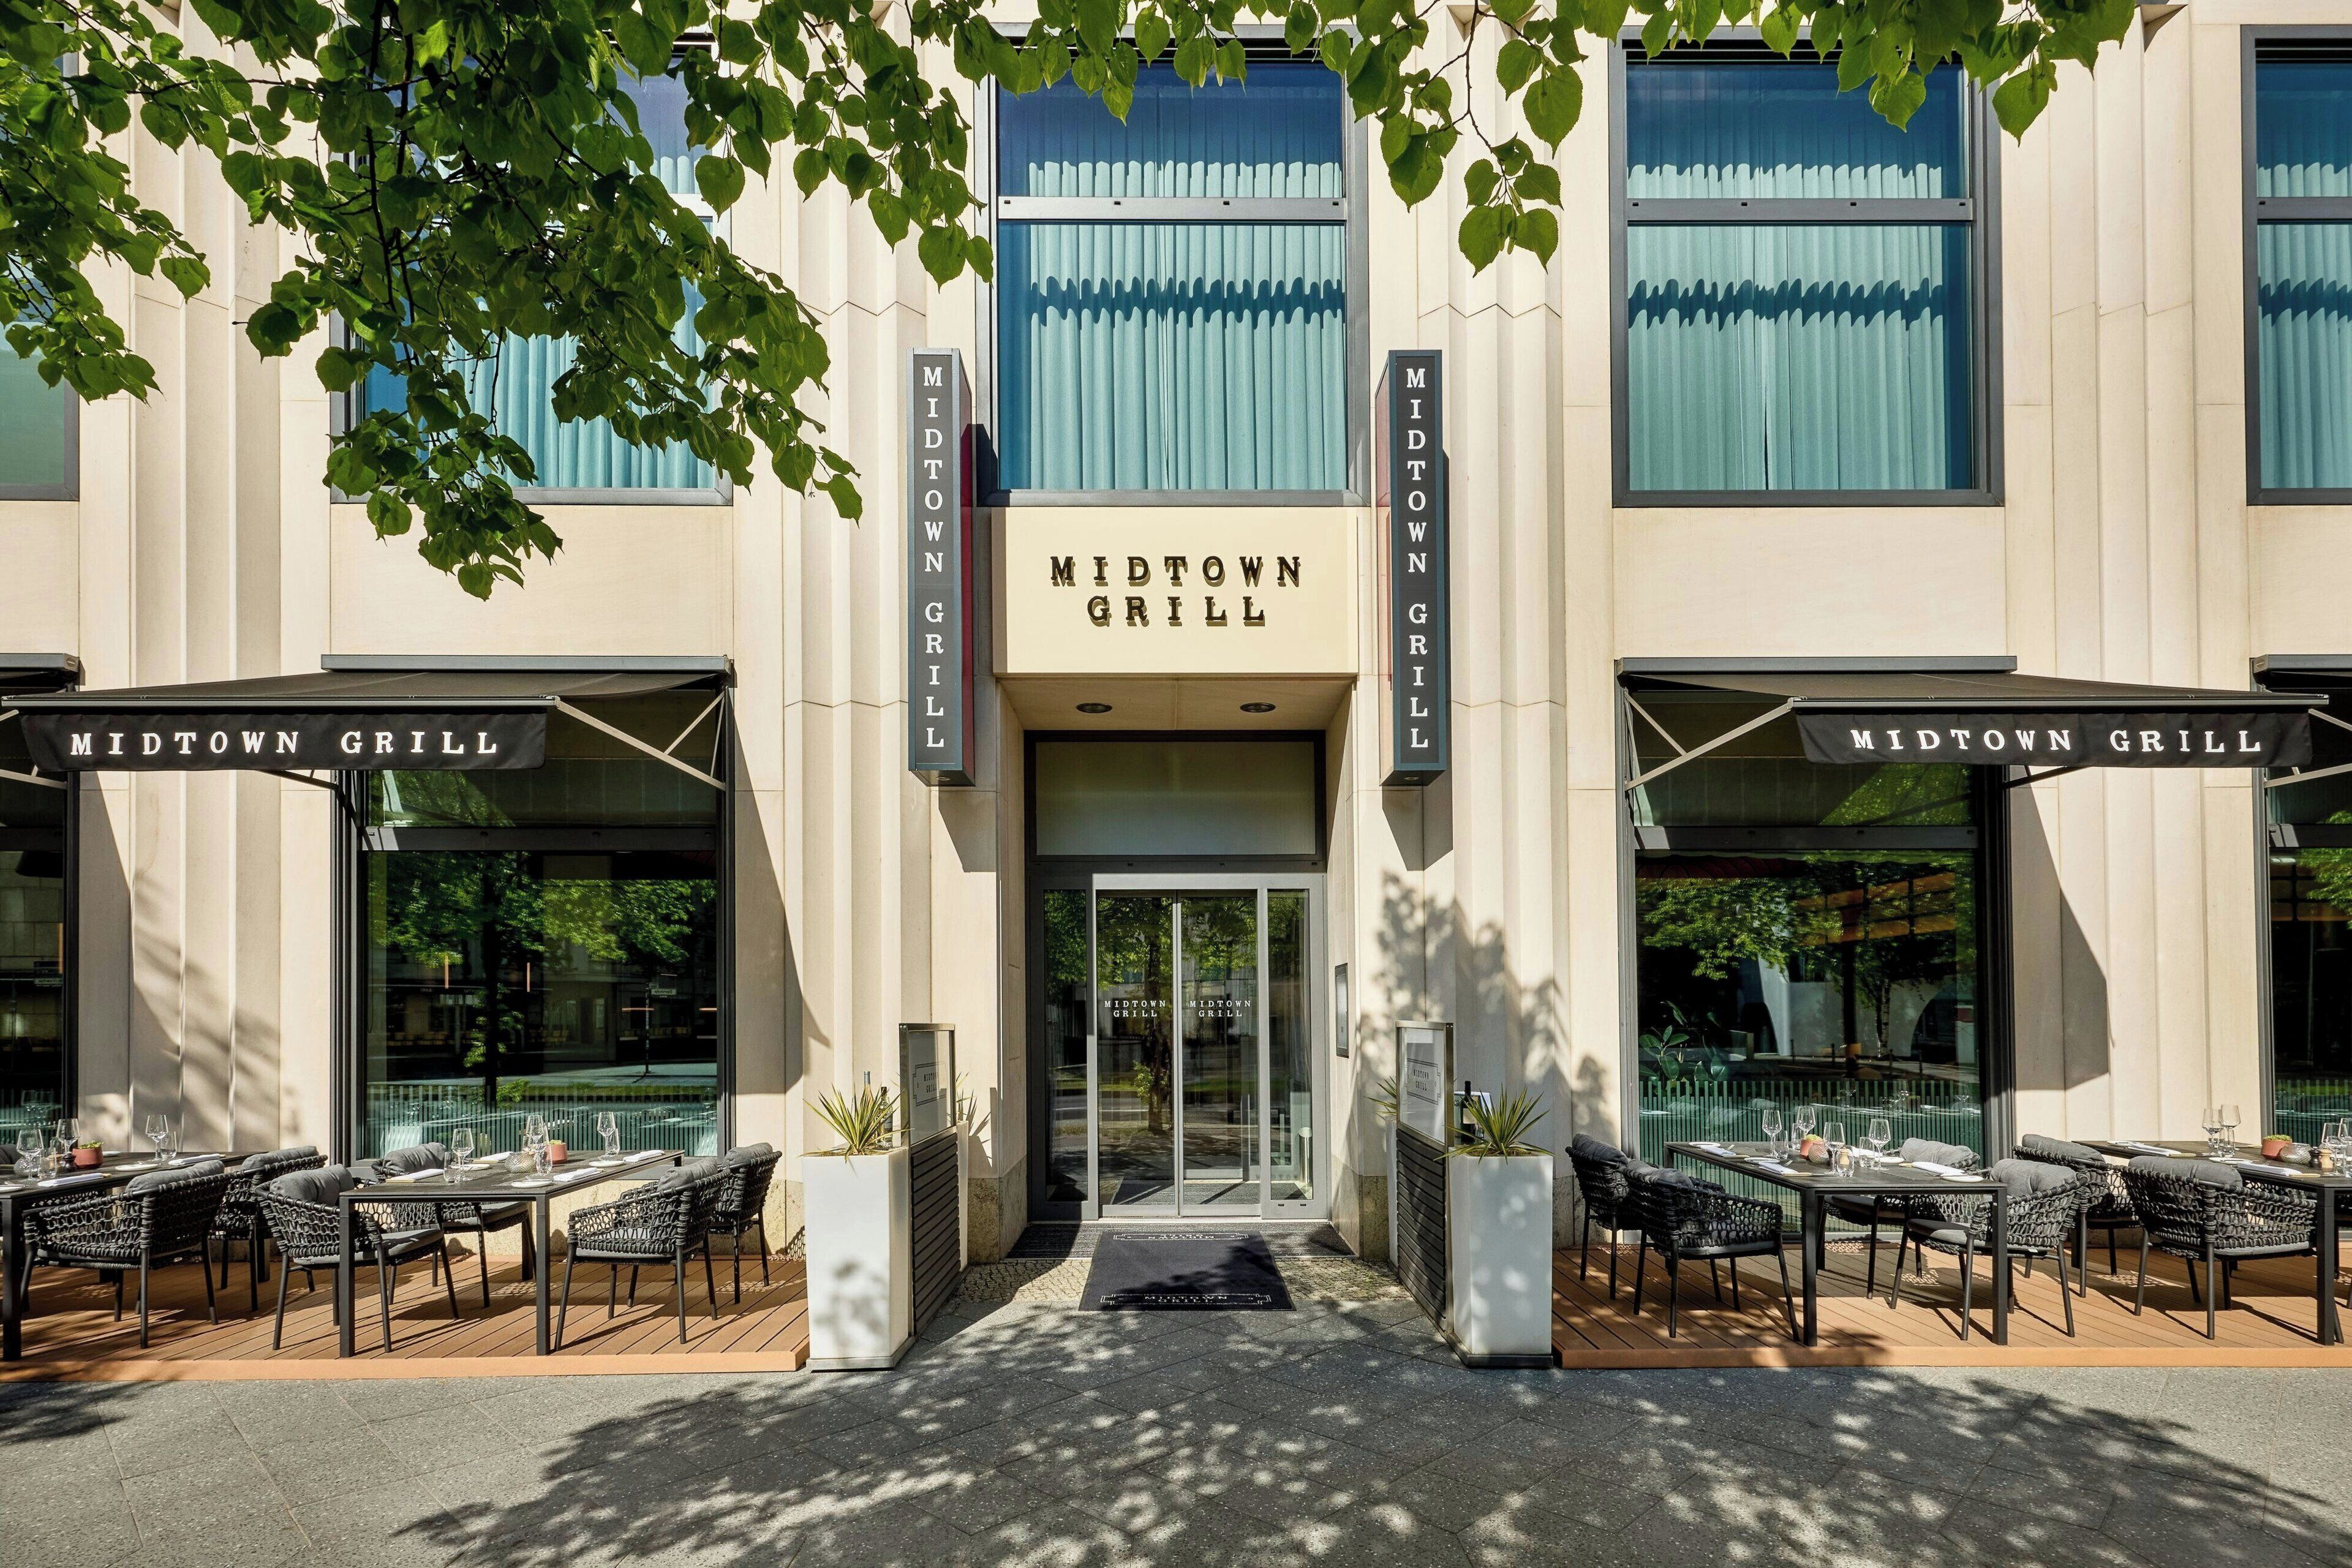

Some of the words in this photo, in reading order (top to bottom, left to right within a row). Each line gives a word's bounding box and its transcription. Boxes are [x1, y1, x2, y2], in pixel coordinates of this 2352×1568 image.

[923, 366, 944, 573] MIDTOWN
[1406, 368, 1427, 573] MIDTOWN
[1050, 556, 1302, 588] MIDTOWN
[1087, 595, 1265, 628] GRILL
[925, 602, 944, 748] GRILL
[1409, 603, 1428, 748] GRILL
[70, 731, 299, 756] MIDTOWN
[341, 731, 497, 755] GRILL
[1850, 729, 2071, 752] MIDTOWN
[2109, 729, 2261, 753] GRILL
[1414, 1069, 1429, 1079] MIDTOWN
[1415, 1081, 1427, 1091] GRILL
